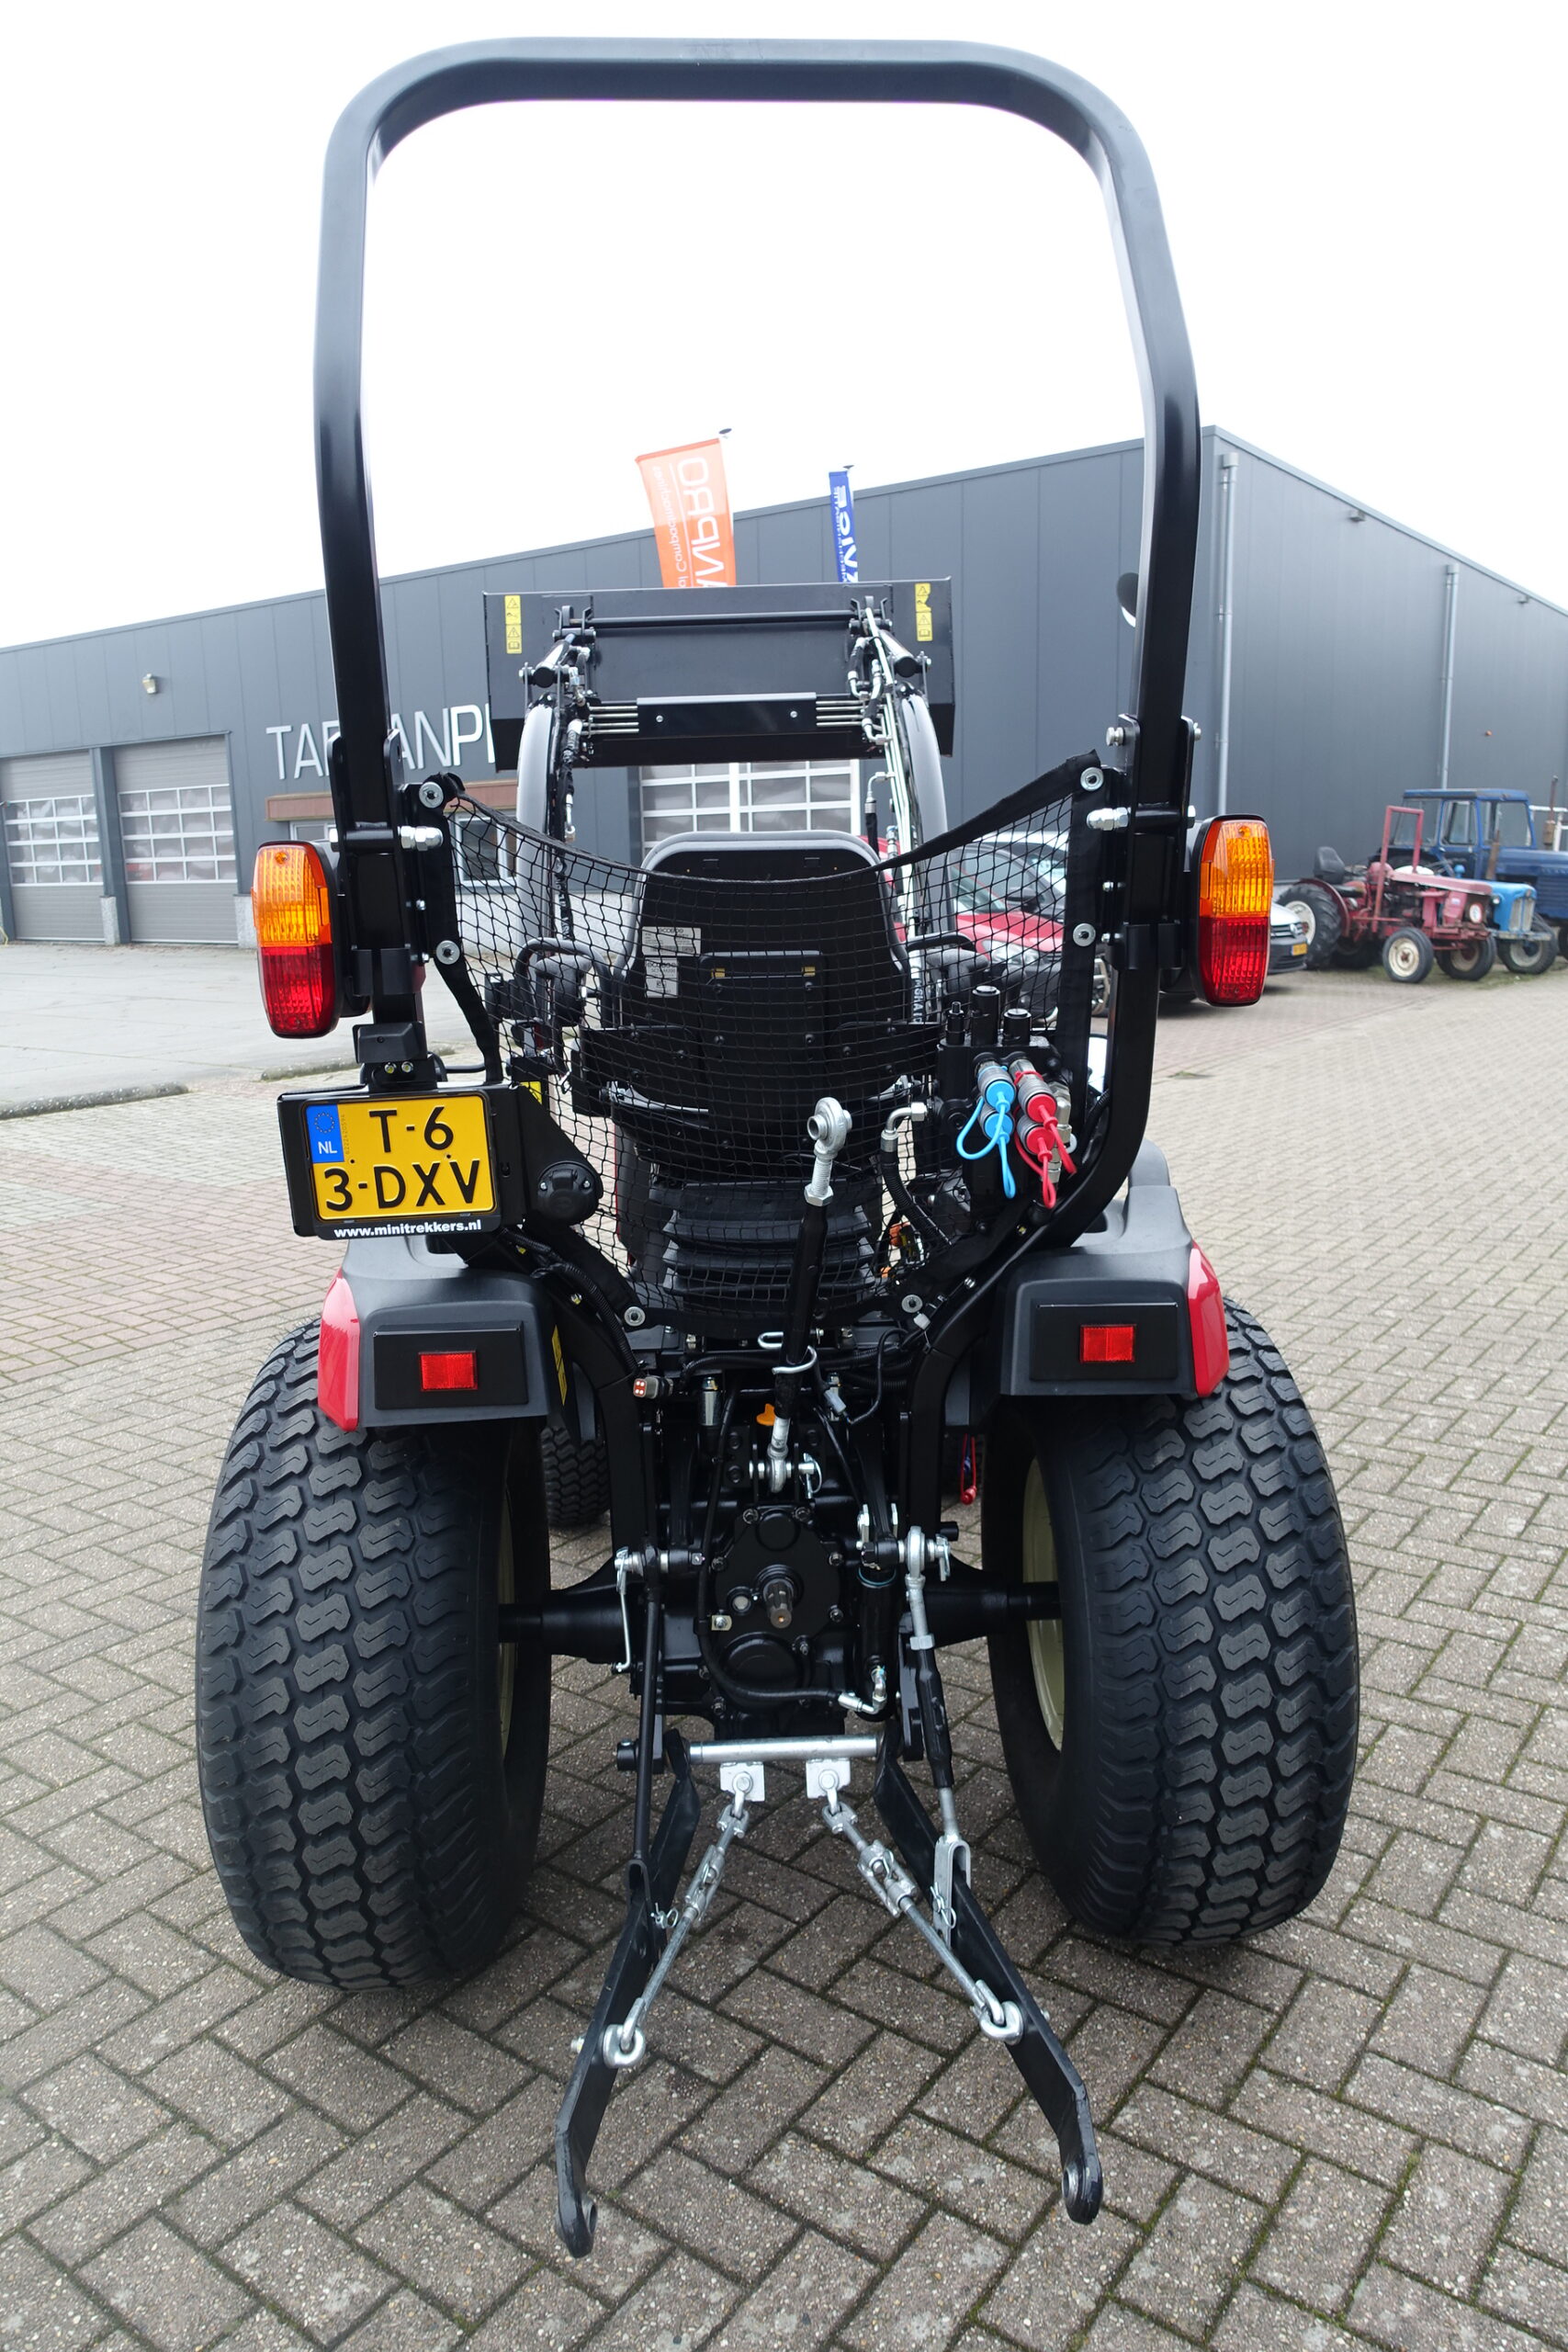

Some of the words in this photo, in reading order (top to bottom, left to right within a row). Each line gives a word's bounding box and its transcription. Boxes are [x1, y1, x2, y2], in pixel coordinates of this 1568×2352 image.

[369, 1105, 454, 1153] T-6
[318, 1141, 338, 1154] NL
[324, 1159, 480, 1211] 3-DXV
[333, 1219, 482, 1238] www.minitrekkers.nl
